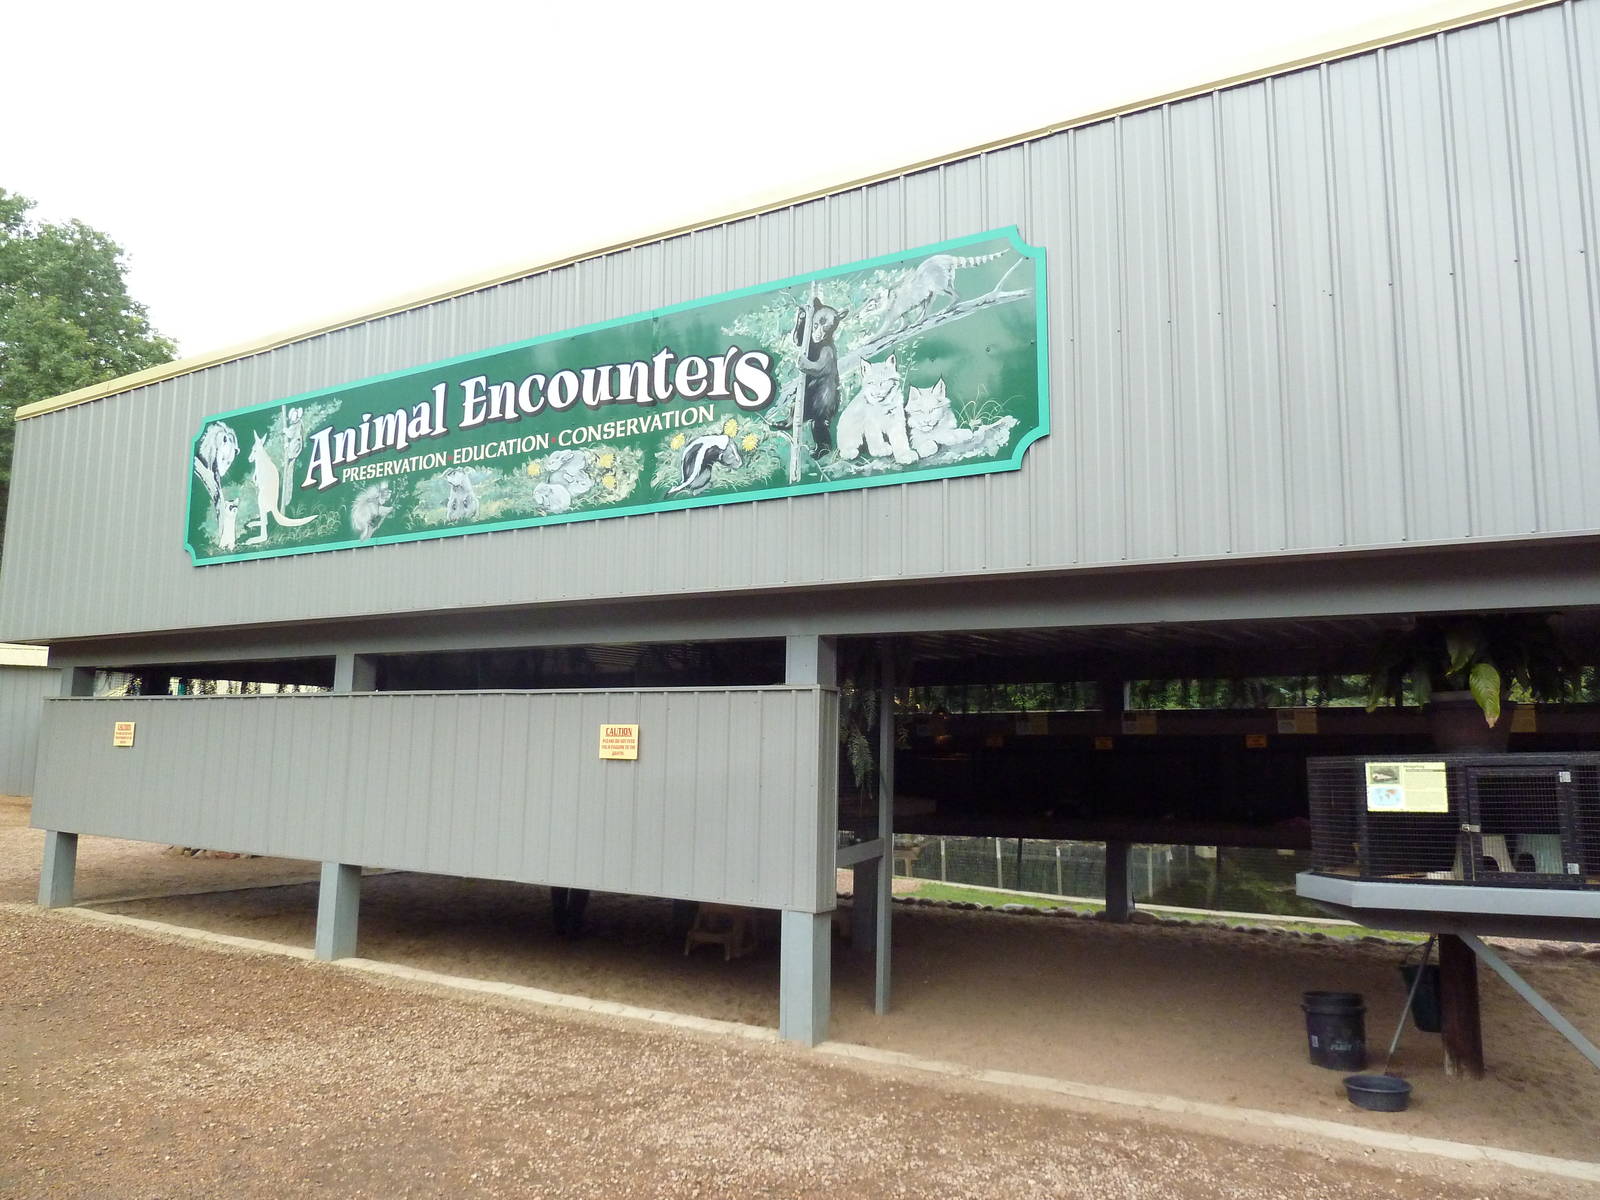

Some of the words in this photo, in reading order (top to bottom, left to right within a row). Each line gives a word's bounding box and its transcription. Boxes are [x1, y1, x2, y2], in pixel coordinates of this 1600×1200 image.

[301, 382, 449, 490] Animal
[458, 346, 773, 429] Encounters
[341, 451, 448, 484] PRESERVATION
[453, 433, 550, 465] EDUCATION
[558, 404, 715, 447] CONSERVATION
[605, 727, 632, 737] CAUTION
